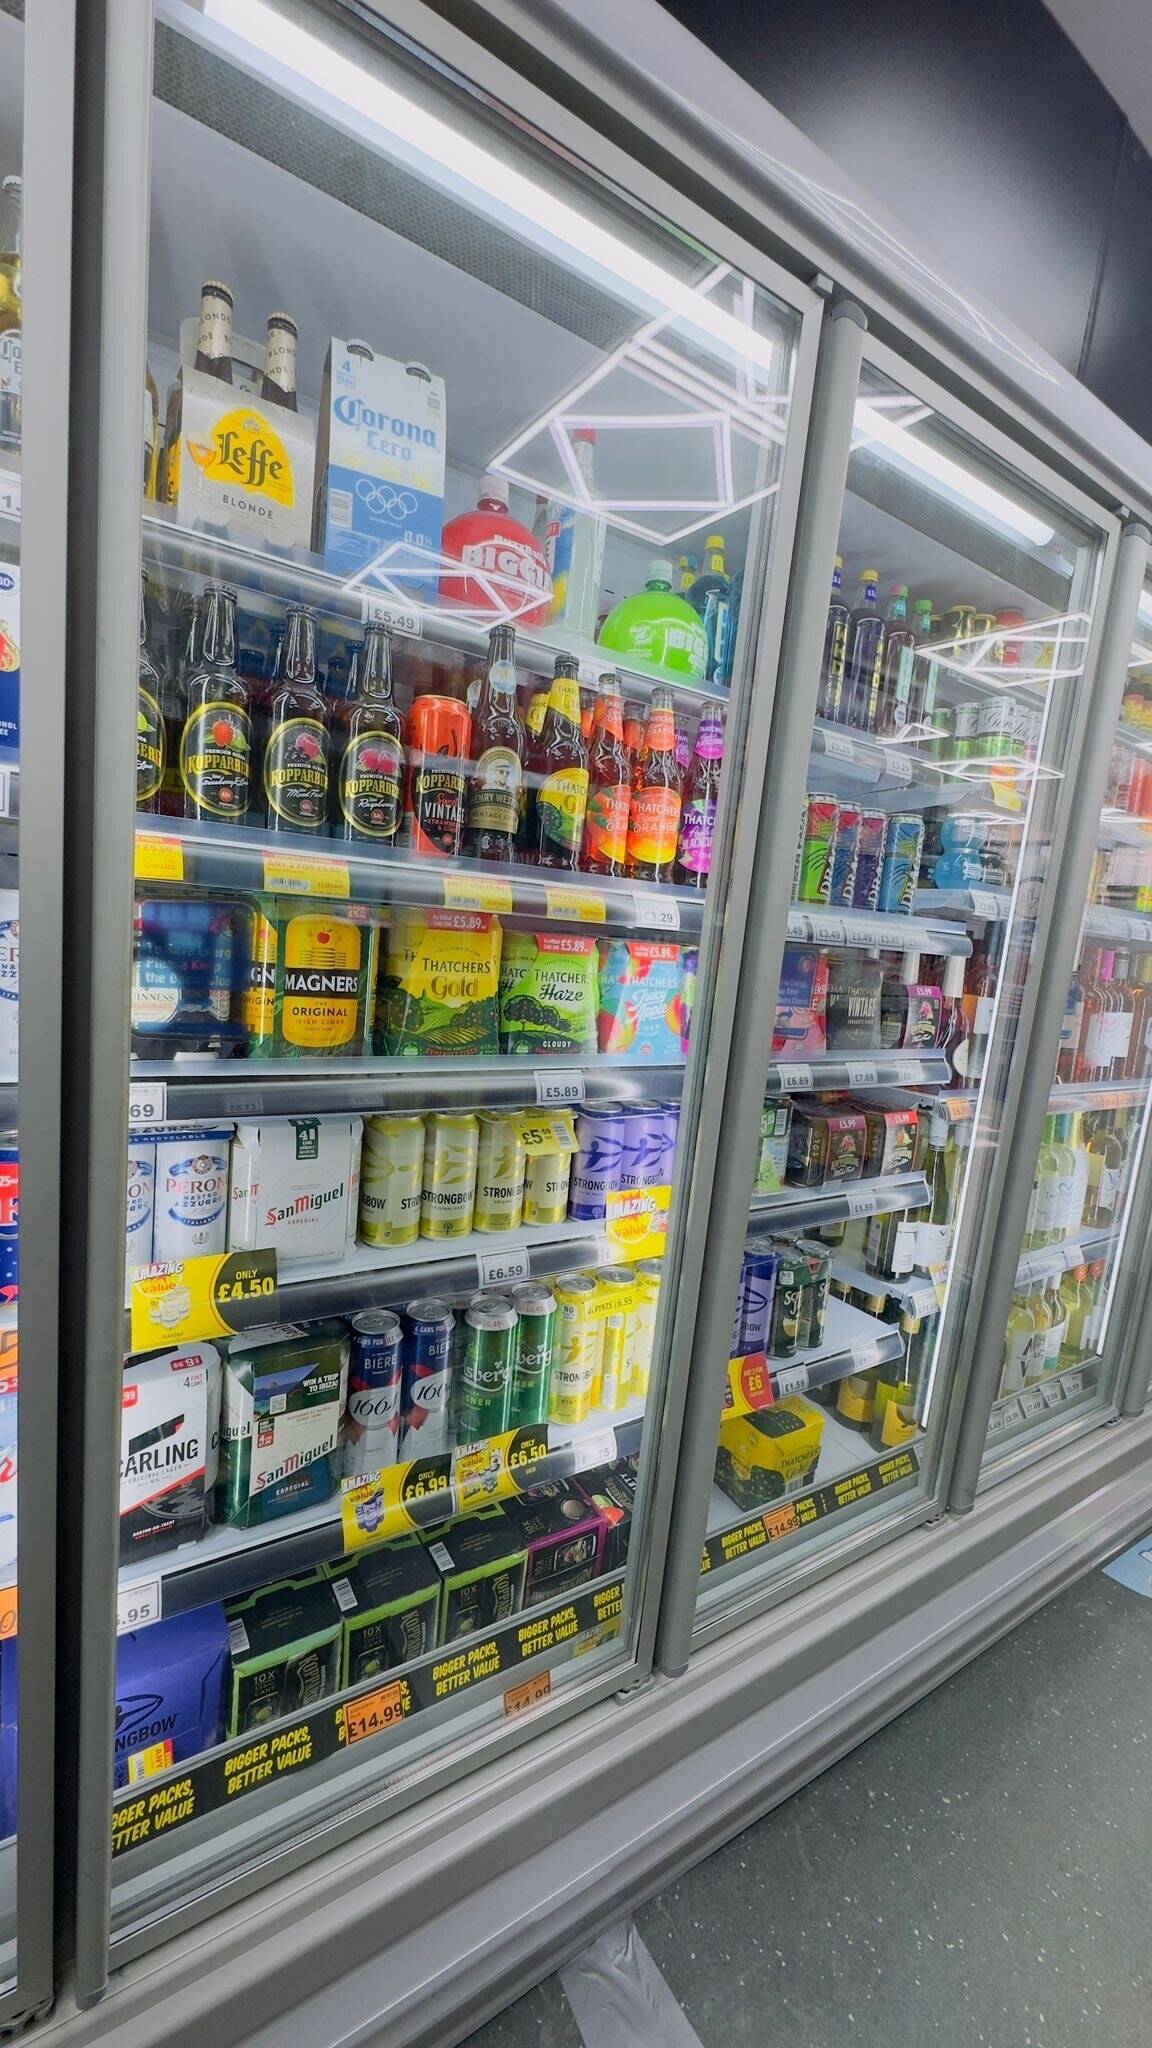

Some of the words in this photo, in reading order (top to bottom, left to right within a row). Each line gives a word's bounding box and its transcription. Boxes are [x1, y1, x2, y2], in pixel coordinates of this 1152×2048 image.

[342, 361, 351, 373] 4
[333, 395, 437, 449] Corona
[366, 430, 412, 462] Cero
[217, 431, 283, 487] Leffe
[222, 494, 274, 520] BLONDE
[373, 607, 414, 630] £5.49
[633, 822, 678, 834] ORANGE
[453, 915, 482, 931] £5.89
[818, 928, 841, 939] £3.49
[852, 933, 873, 943] £3.49
[560, 939, 586, 954] £5.89
[649, 946, 672, 960] £5.89
[422, 957, 491, 974] THATCHERS
[285, 973, 358, 993] MAGNERS
[431, 975, 479, 1000] Gold
[539, 982, 585, 1001] Haze
[292, 1006, 348, 1016] ORIGINAL
[848, 997, 877, 1017] VINTAGE
[542, 1040, 572, 1049] CLOUDY
[546, 1085, 578, 1098] £5.89
[143, 1132, 206, 1141] RECYCLABLE
[184, 1191, 217, 1200] NASTRO
[855, 1202, 874, 1214] £1.59
[615, 1224, 648, 1237] value
[131, 1260, 184, 1284] AMAZING
[235, 1268, 258, 1281] ONLY
[489, 1264, 523, 1280] £6.59
[142, 1282, 177, 1295] value
[217, 1276, 275, 1304] £4.50
[564, 1304, 574, 1314] NO
[183, 1376, 190, 1389] 4
[303, 1378, 316, 1387] WIN
[317, 1377, 323, 1385] A
[324, 1373, 339, 1383] TRIP
[309, 1383, 319, 1393] TO
[319, 1379, 339, 1390] IBIZA!
[748, 1374, 763, 1391] £6
[785, 1379, 806, 1392] £1.59
[453, 1440, 490, 1460] AMAZING
[520, 1438, 537, 1450] ONLY
[460, 1456, 485, 1469] value
[507, 1443, 547, 1469] £6.50
[781, 1447, 819, 1469] THATCHERS
[128, 1471, 159, 1485] ORIGINAL
[161, 1466, 183, 1477] LAGER
[341, 1470, 382, 1491] AMAZING
[418, 1469, 436, 1482] ONLY
[275, 1480, 310, 1496] ESPECIAL
[349, 1488, 376, 1504] value
[405, 1474, 448, 1501] £6.99
[835, 1479, 853, 1497] BIGGER
[838, 1488, 857, 1506] BETTER
[857, 1482, 872, 1499] VALUE
[796, 1497, 816, 1513] PACKS,
[800, 1508, 818, 1525] VALUE
[721, 1528, 744, 1548] BIGGER
[744, 1519, 764, 1538] PACKS,
[768, 1516, 799, 1539] £14.99
[725, 1542, 747, 1560] BETTER
[749, 1531, 767, 1549] VALUE
[460, 1584, 477, 1598] 10X
[593, 1585, 621, 1608] BIGGER
[362, 1625, 383, 1639] 10X
[518, 1619, 549, 1642] BIGGER
[550, 1606, 577, 1629] PACKS,
[522, 1632, 554, 1657] BETTER
[555, 1619, 578, 1642] VALUE
[432, 1658, 466, 1681] BIGGER
[467, 1641, 499, 1663] PACKS,
[254, 1670, 276, 1685] 10X
[435, 1673, 471, 1697] BETTER
[473, 1656, 500, 1680] VALUE
[349, 1701, 404, 1738] £14.99
[224, 1743, 268, 1778] BIGGER
[270, 1725, 312, 1756] PACKS,
[227, 1759, 273, 1796] BETTER
[276, 1741, 313, 1772] VALUE
[148, 1778, 194, 1814] PACKS,
[154, 1796, 196, 1831] VALUE
